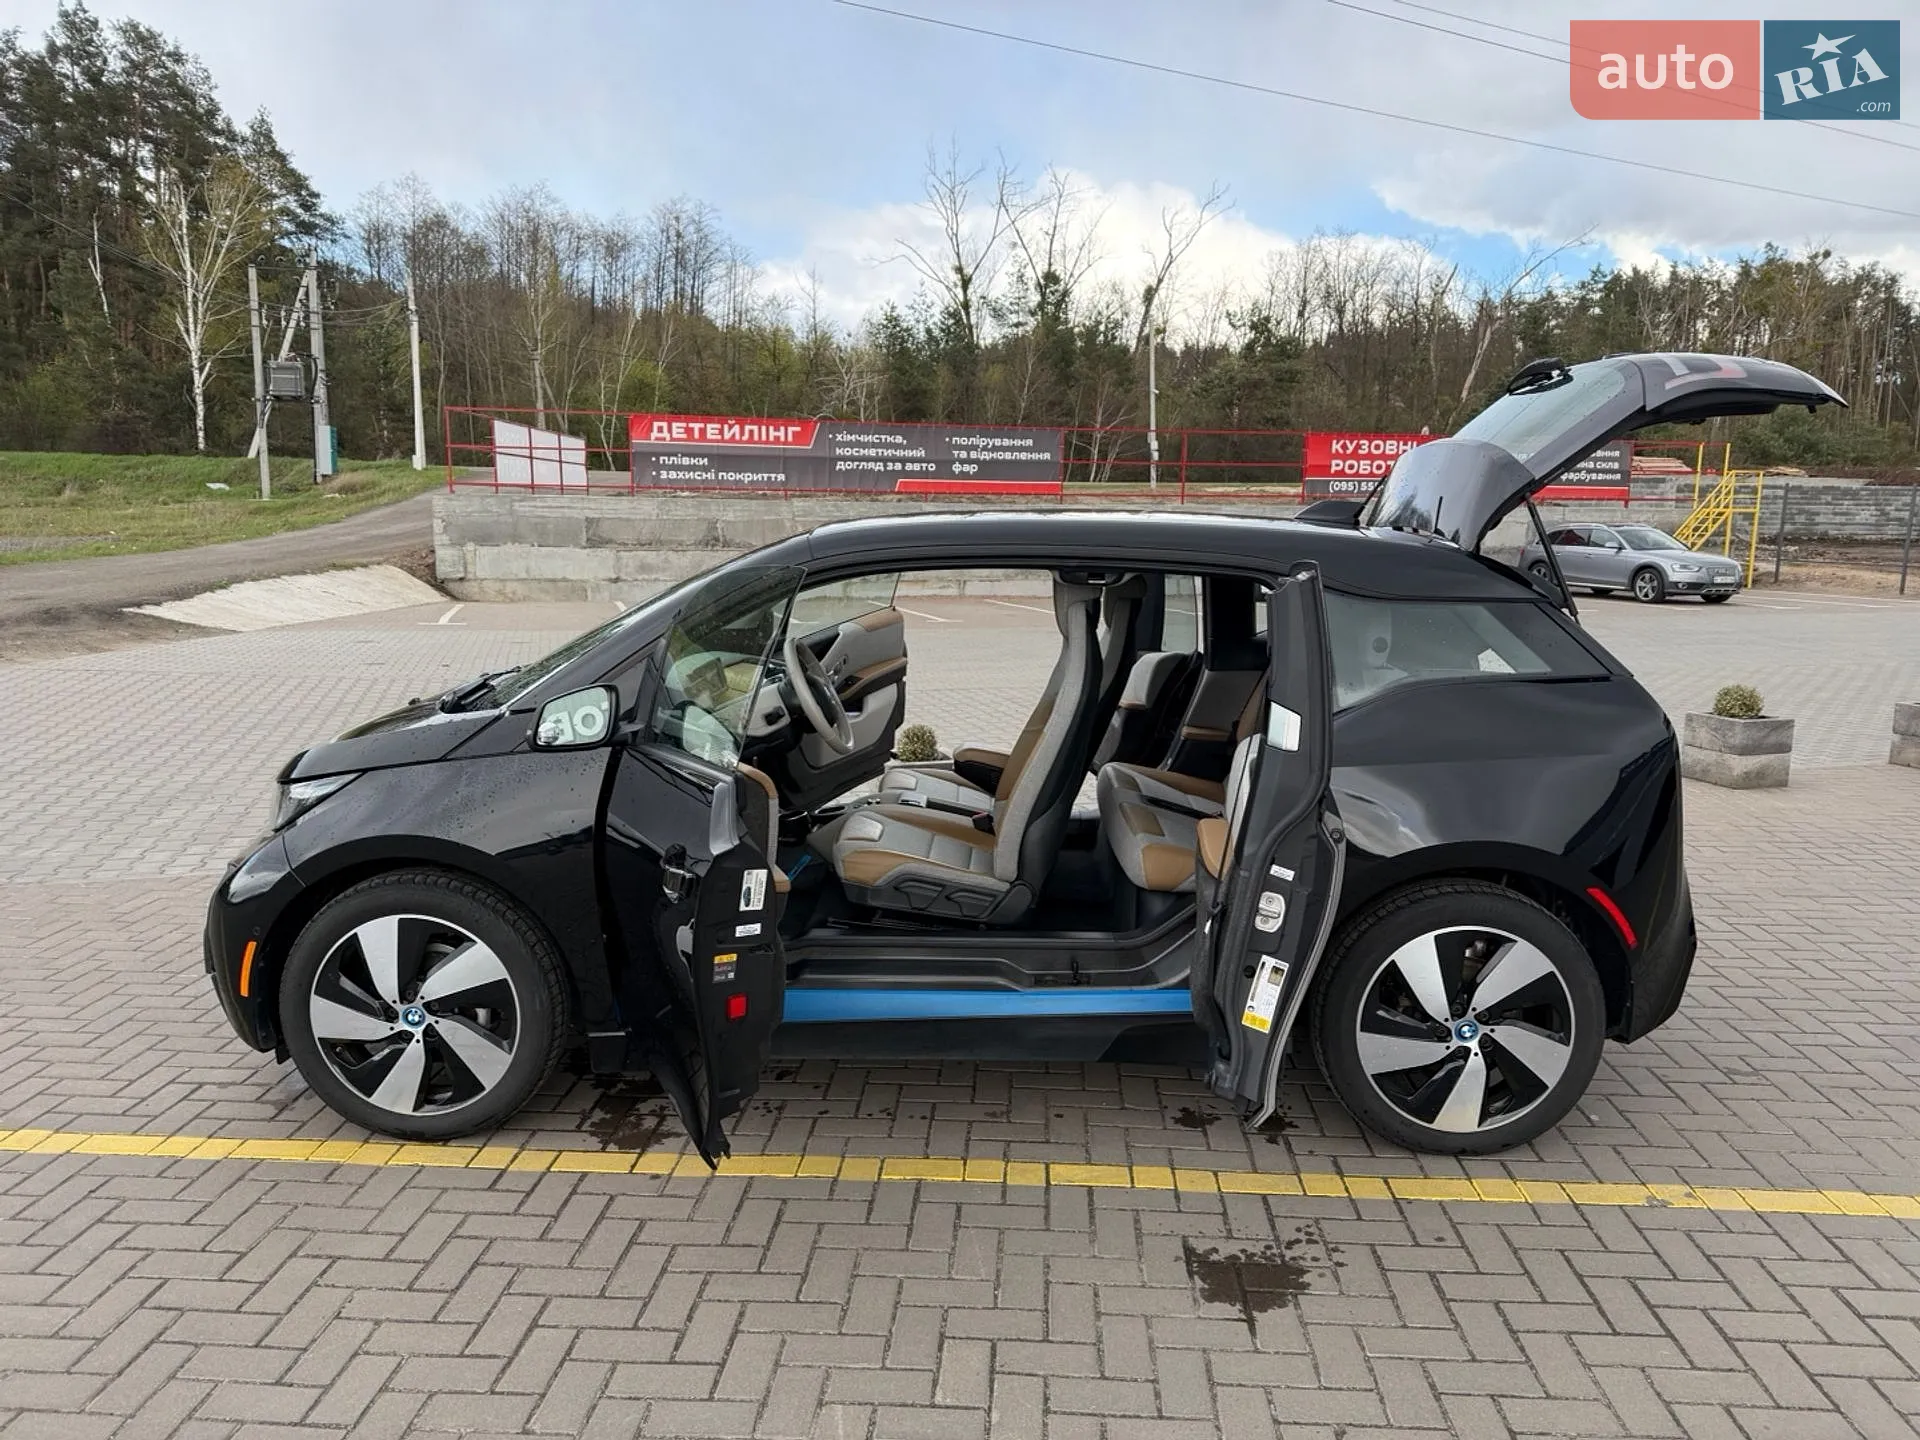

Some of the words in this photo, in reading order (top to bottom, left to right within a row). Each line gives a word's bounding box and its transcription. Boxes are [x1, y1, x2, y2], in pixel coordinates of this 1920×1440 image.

[650, 420, 802, 443] ДЕТЕЙЛІНГ
[835, 430, 908, 445] хімчистка,
[951, 434, 1034, 449] полірування
[835, 446, 926, 458] косметичний
[952, 449, 968, 459] та
[969, 447, 1052, 461] відновлення
[659, 453, 709, 466] плівки
[835, 460, 885, 472] догляд
[886, 461, 902, 471] за
[904, 461, 937, 472] авто
[1595, 461, 1620, 469] скла
[951, 461, 979, 475] фар
[659, 469, 715, 481] захисні
[718, 471, 786, 484] покриття
[1329, 480, 1359, 493] (095)
